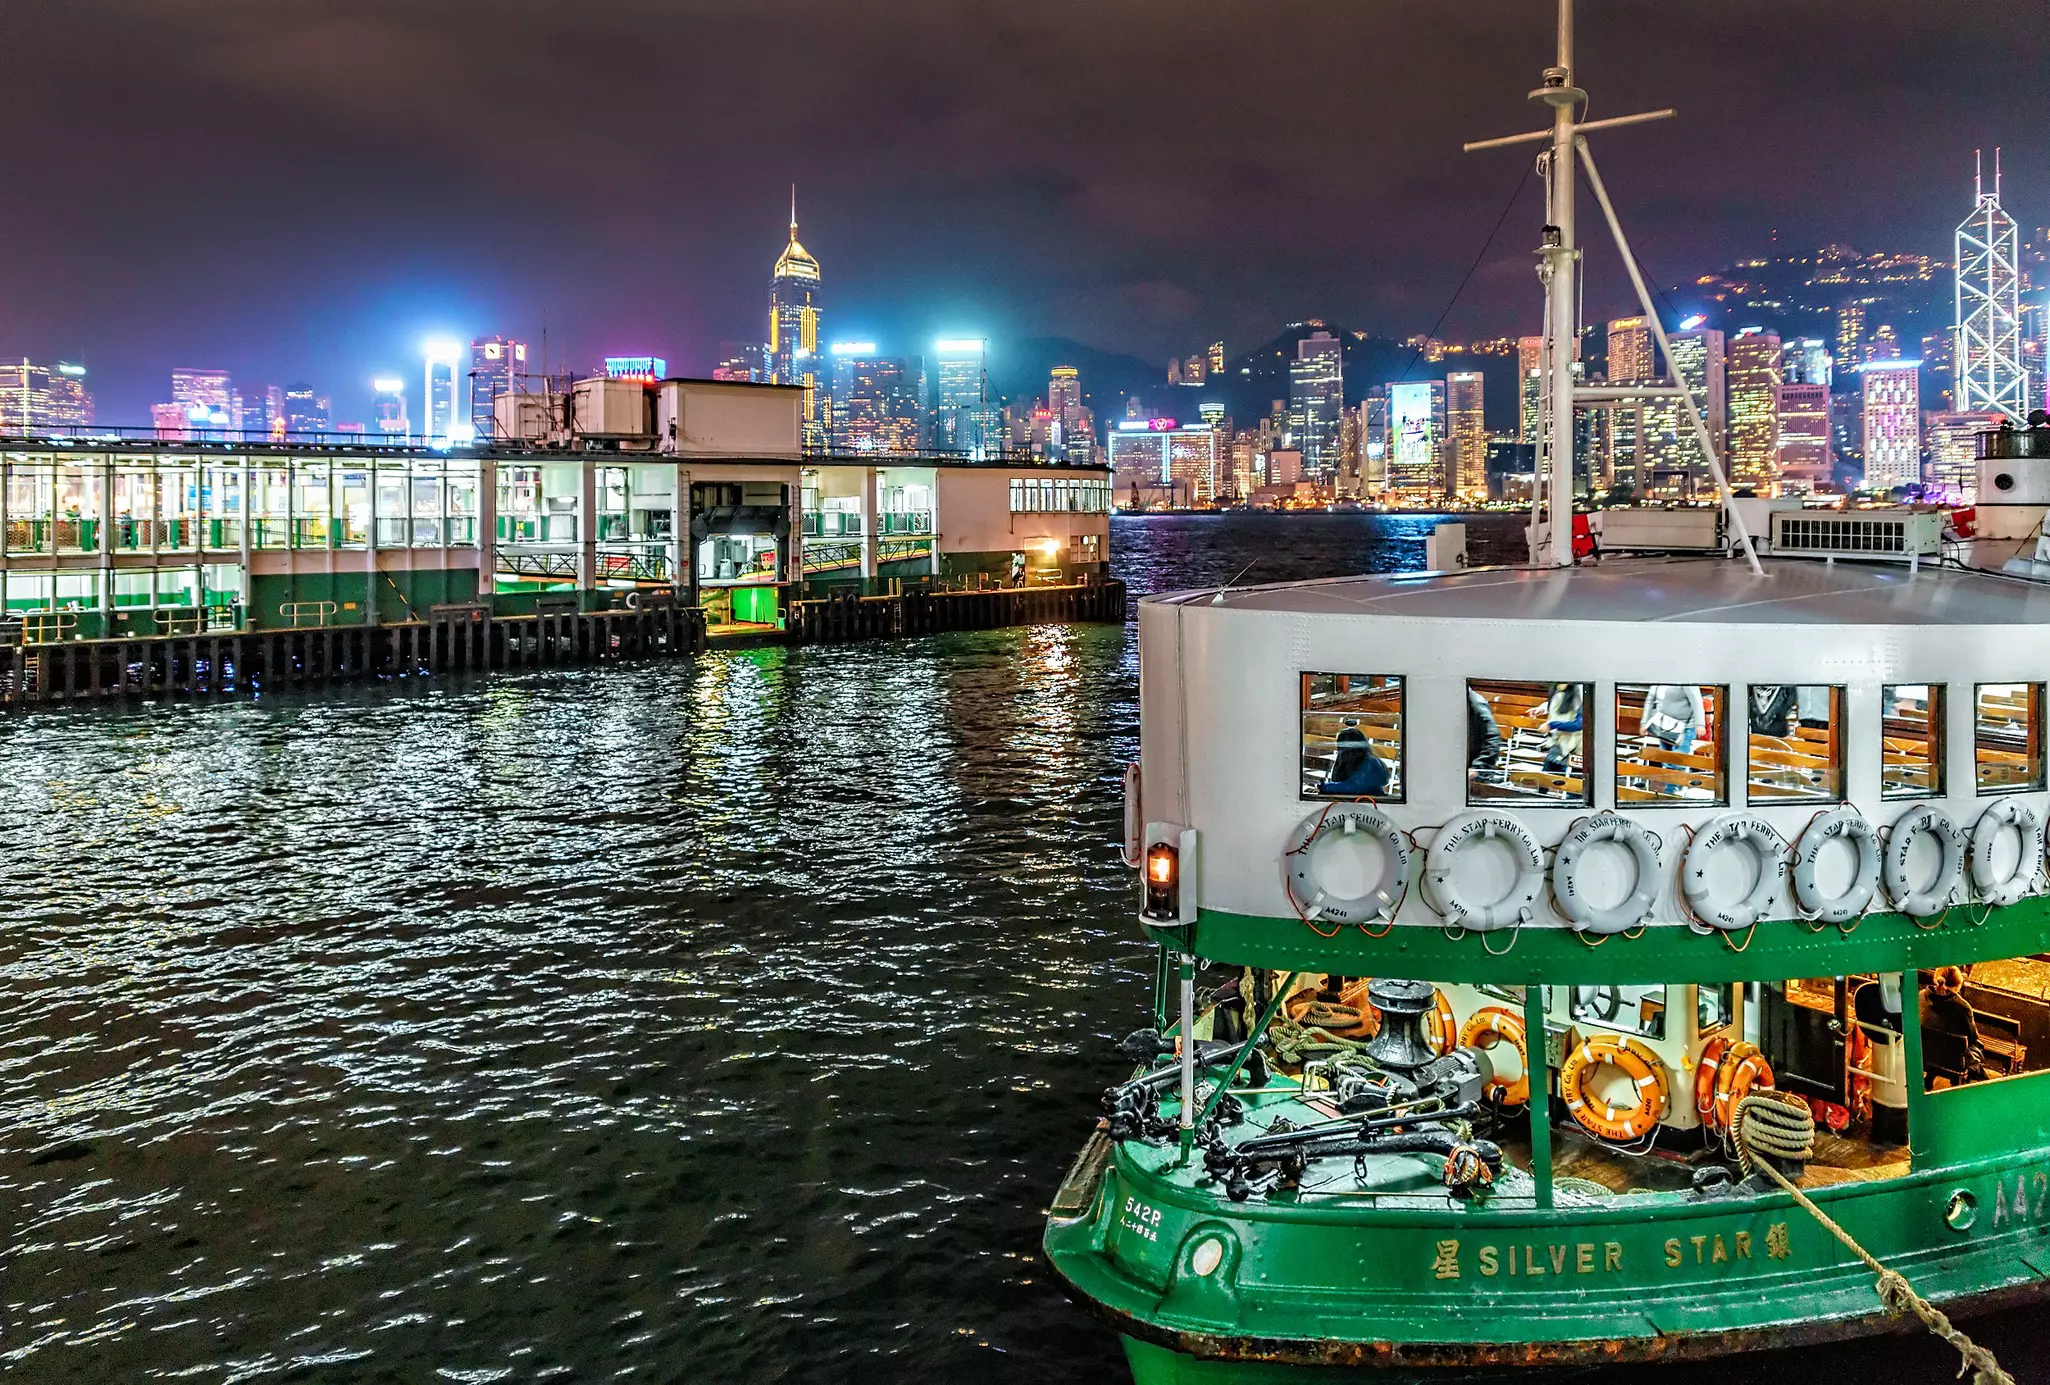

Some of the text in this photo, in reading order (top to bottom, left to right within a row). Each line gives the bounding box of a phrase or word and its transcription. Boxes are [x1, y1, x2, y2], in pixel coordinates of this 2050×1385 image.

[1444, 833, 1462, 853] THE
[1705, 831, 1722, 849] THE
[1750, 820, 1776, 841] FERRY
[1807, 844, 1820, 864] THE
[1567, 876, 1575, 897] A4241
[1325, 906, 1347, 918] A4241
[1644, 1098, 1652, 1117] A4241
[1605, 1129, 1623, 1139] THE
[1431, 1239, 1461, 1280] 星
[1479, 1241, 1625, 1277] SILVER
[1664, 1230, 1753, 1268] STAR
